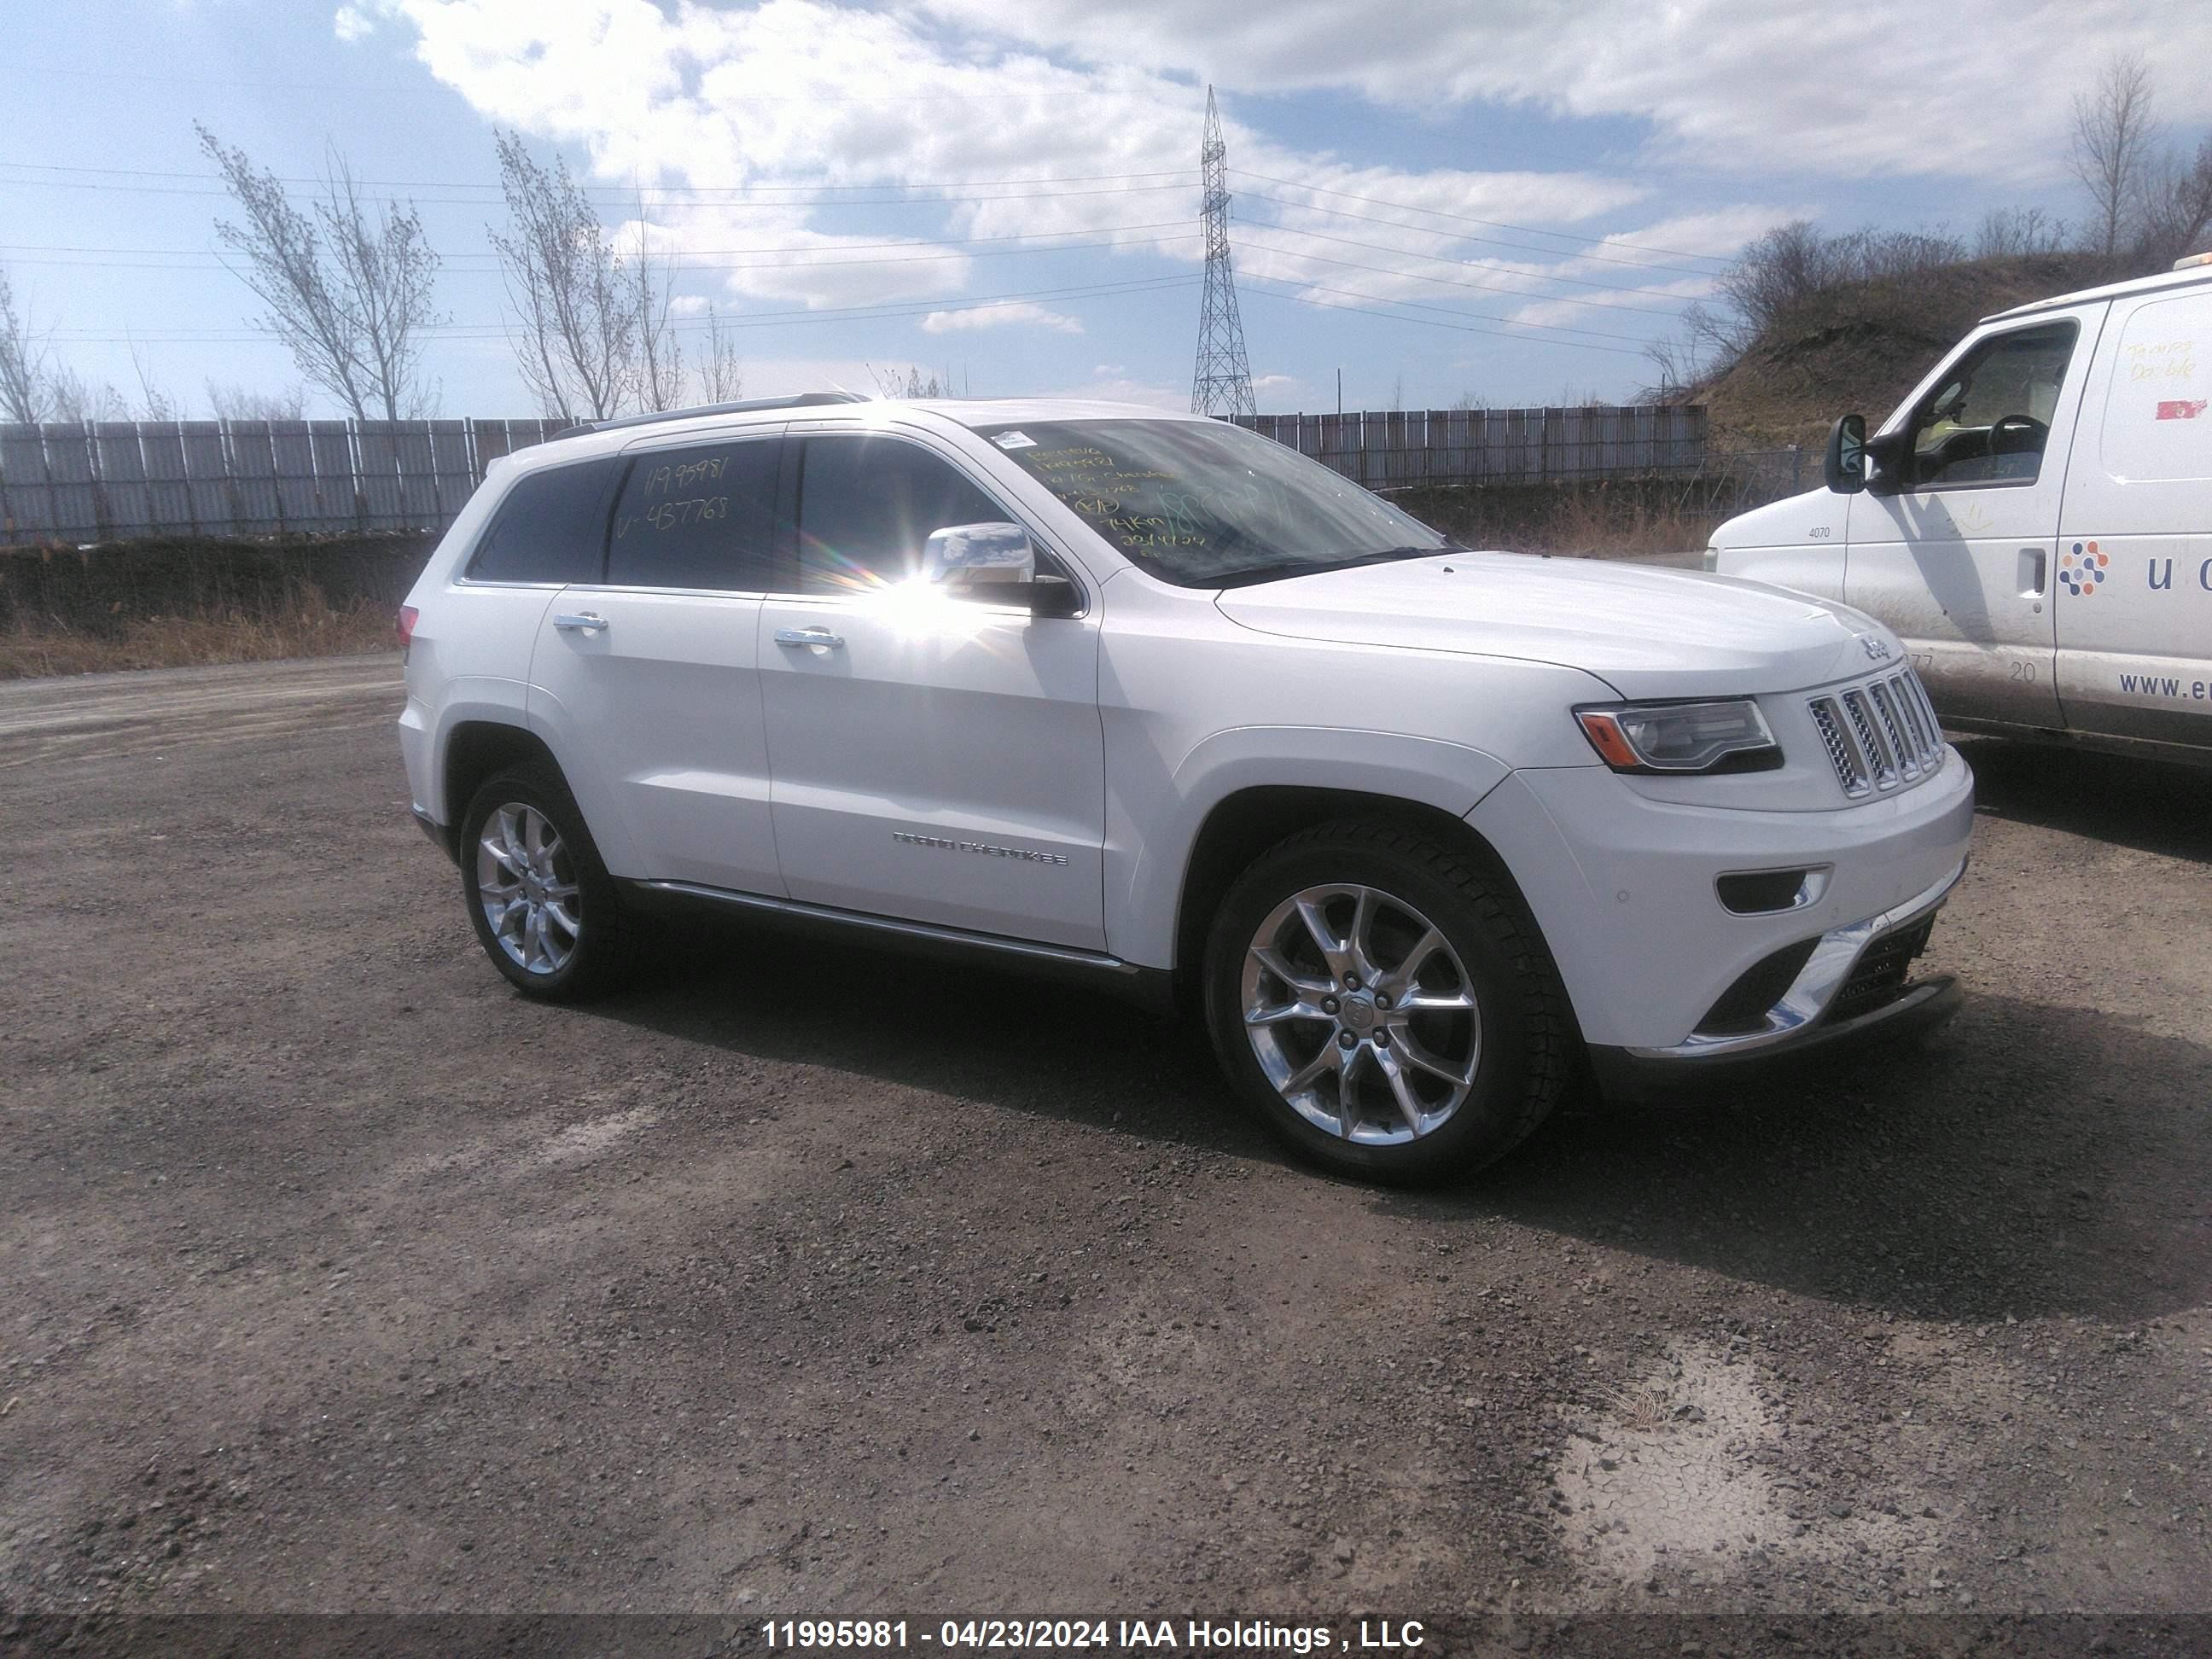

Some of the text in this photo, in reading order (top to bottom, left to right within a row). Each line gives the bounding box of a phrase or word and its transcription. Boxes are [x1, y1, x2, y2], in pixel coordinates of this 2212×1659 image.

[645, 457, 729, 497] 11995981
[1808, 527, 1831, 538] 4070
[2010, 661, 2036, 683] 20
[2120, 674, 2212, 700] www.e
[959, 841, 1069, 866] CHEROKEE
